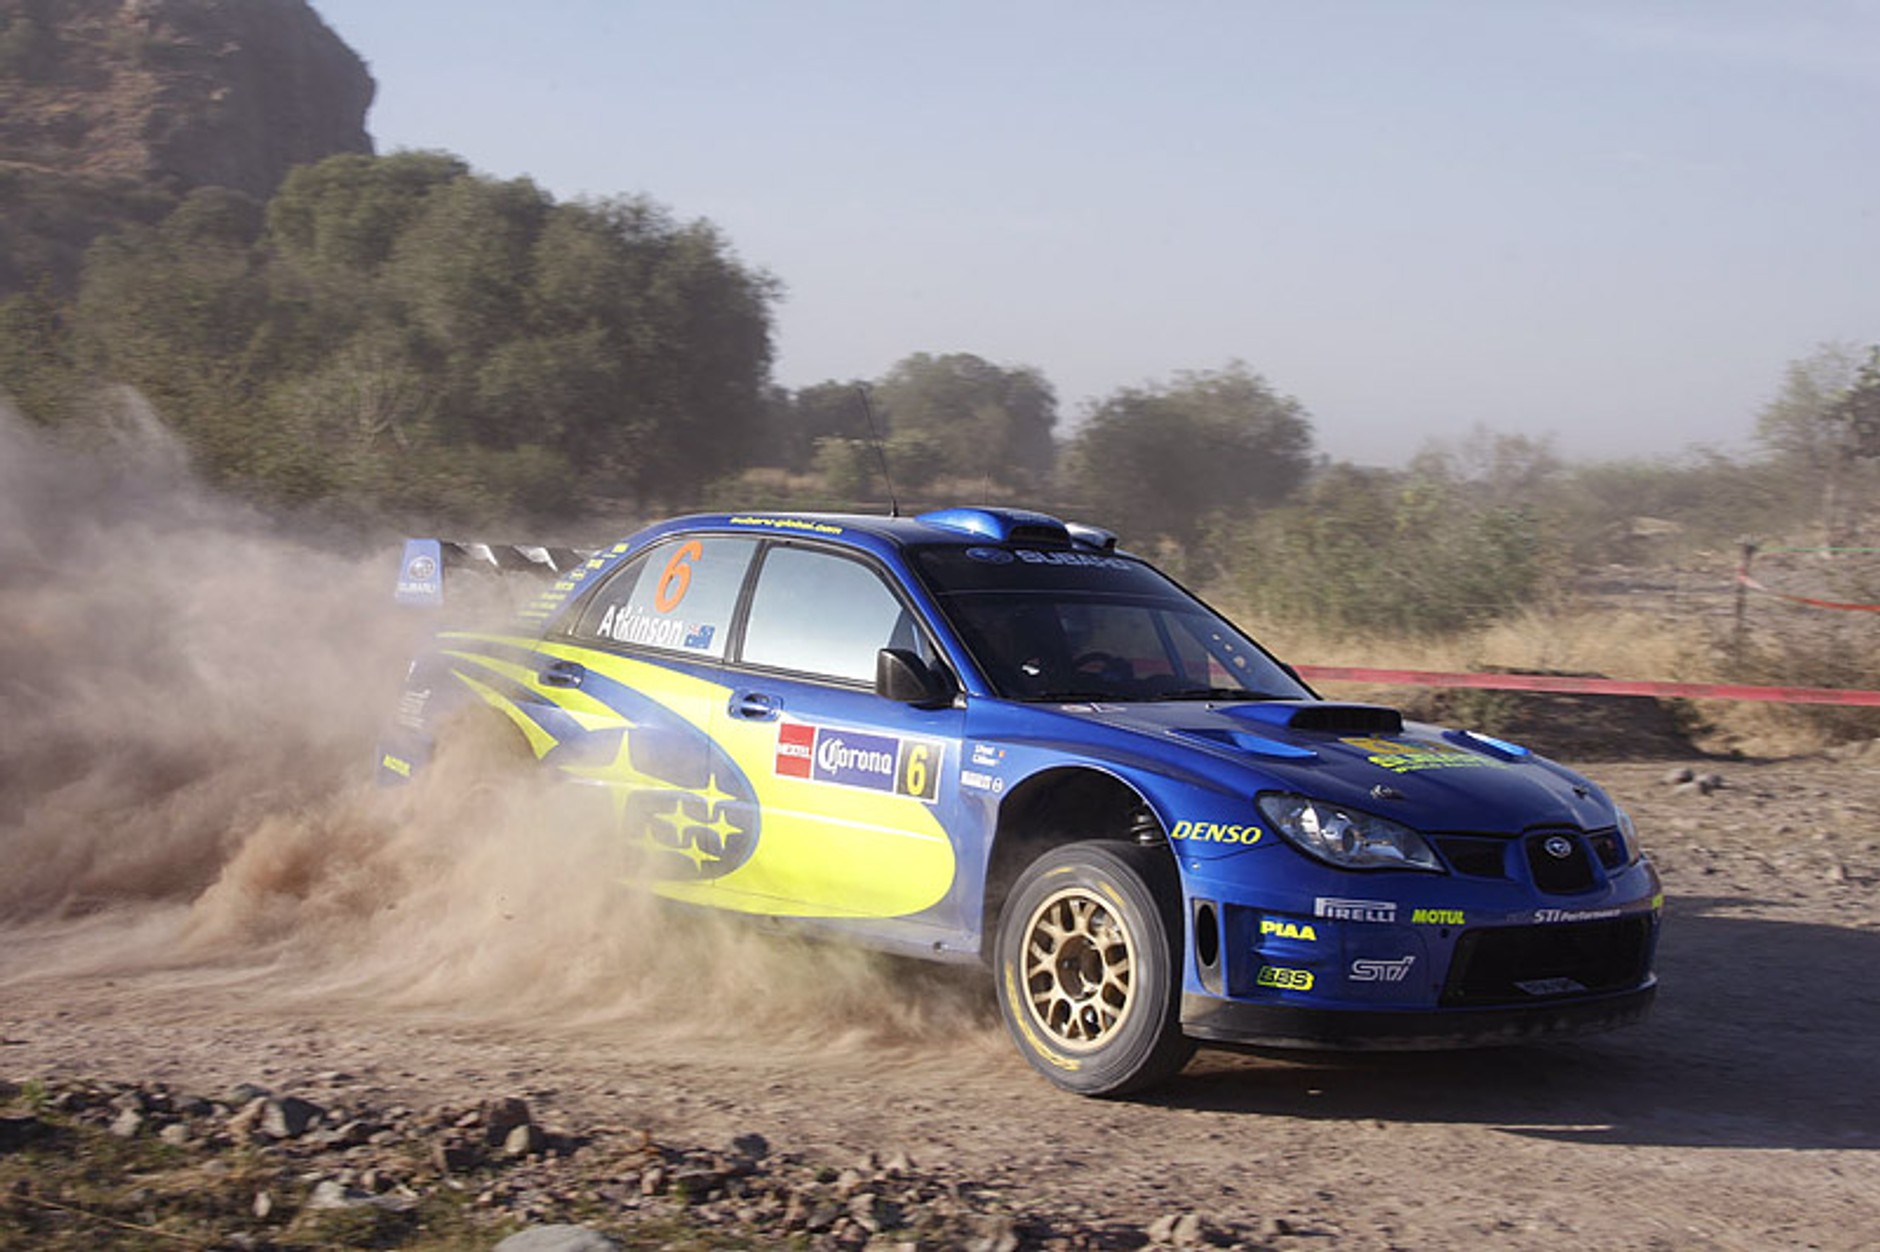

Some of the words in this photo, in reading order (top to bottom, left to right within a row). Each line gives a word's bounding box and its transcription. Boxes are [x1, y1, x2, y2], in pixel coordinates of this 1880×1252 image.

[655, 540, 703, 613] 6
[596, 604, 683, 645] Atkinson
[817, 737, 893, 774] Corona
[906, 744, 928, 796] 6
[1170, 820, 1262, 845] DENSO
[1314, 897, 1397, 922] PIRELLI
[1412, 909, 1465, 924] MOTUL
[1260, 920, 1316, 941] PIAA
